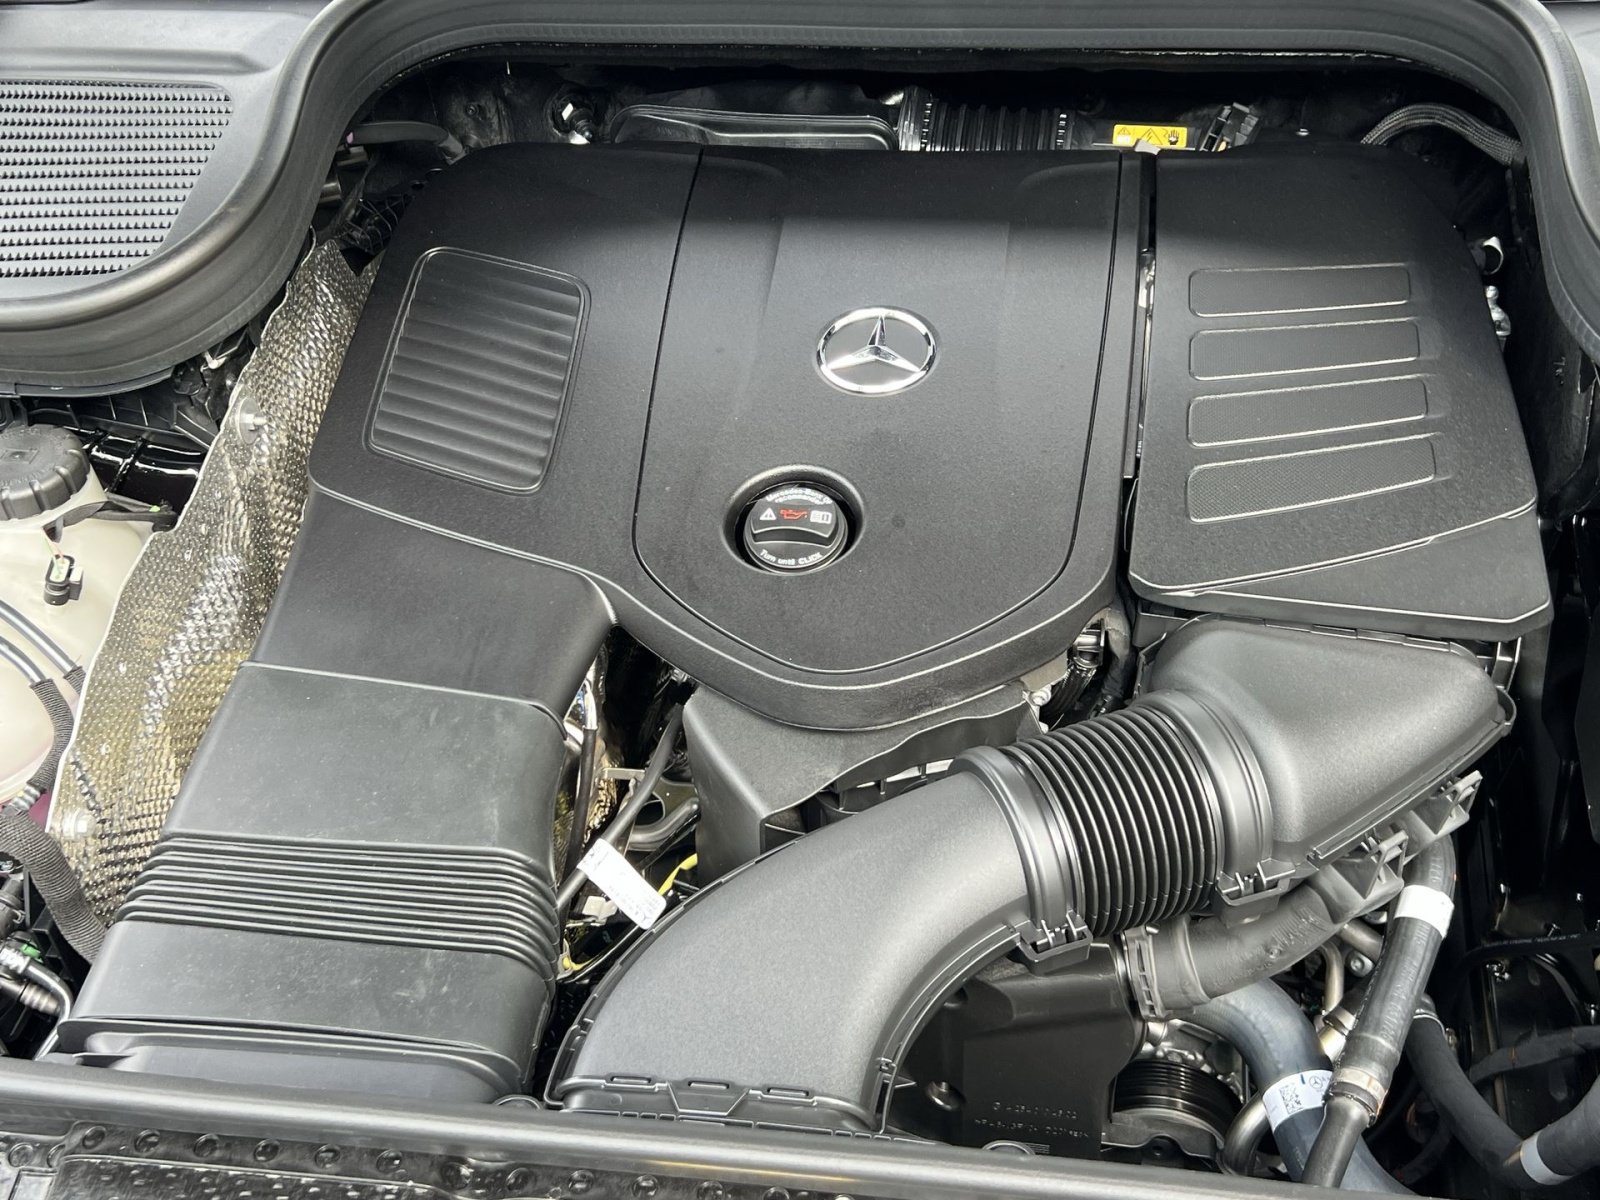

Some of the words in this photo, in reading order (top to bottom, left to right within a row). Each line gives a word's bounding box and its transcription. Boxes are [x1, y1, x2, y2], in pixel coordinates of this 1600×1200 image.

[760, 549, 777, 562] Turn
[777, 558, 796, 566] until
[797, 552, 823, 565] CLICK
